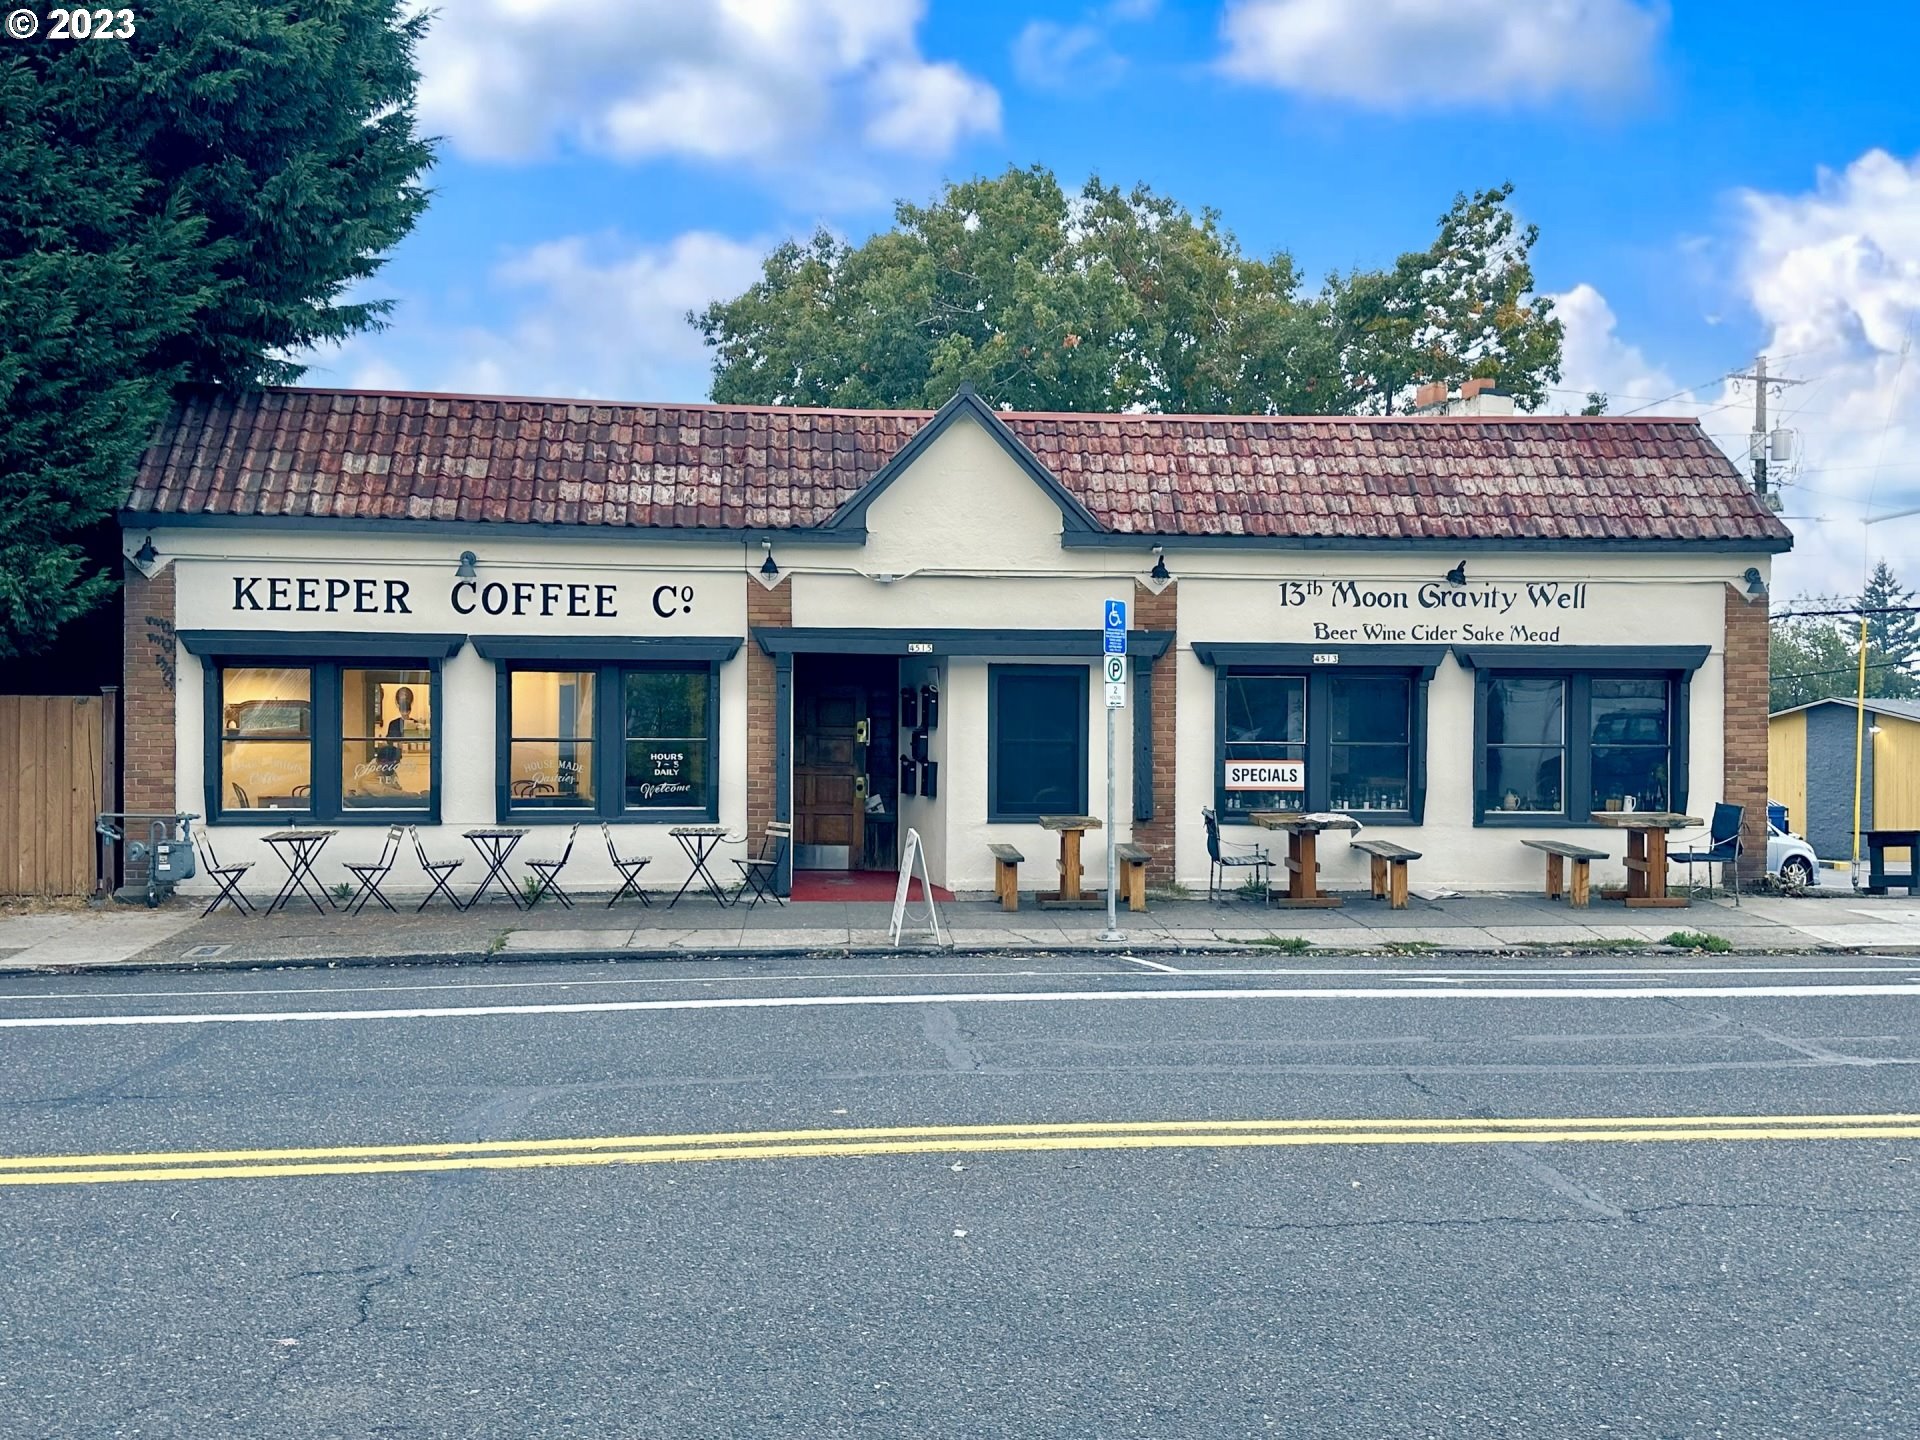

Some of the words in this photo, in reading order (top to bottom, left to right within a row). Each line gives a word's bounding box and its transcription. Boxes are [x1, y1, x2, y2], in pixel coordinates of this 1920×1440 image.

[232, 577, 413, 614] KEEPER
[451, 581, 618, 618] COFFEE
[1279, 580, 1323, 607] 13th
[1332, 580, 1409, 608] Moon
[1418, 582, 1518, 615] Gravity
[1526, 582, 1587, 609] Well
[1313, 622, 1358, 640] Beer
[1362, 623, 1406, 641] Wine
[1411, 624, 1458, 641] Cider
[1462, 624, 1505, 642] Sake
[1510, 625, 1560, 642] Mead
[909, 644, 933, 652] 4515
[1314, 655, 1338, 663] 4513
[1112, 662, 1120, 677] P
[1113, 685, 1118, 694] 2
[523, 760, 553, 773] HOUSE
[559, 760, 585, 773] MADE
[654, 768, 680, 776] DAILY
[532, 771, 575, 788] Pastries
[1231, 768, 1298, 782] SPECIALS
[640, 782, 691, 799] Welcome
